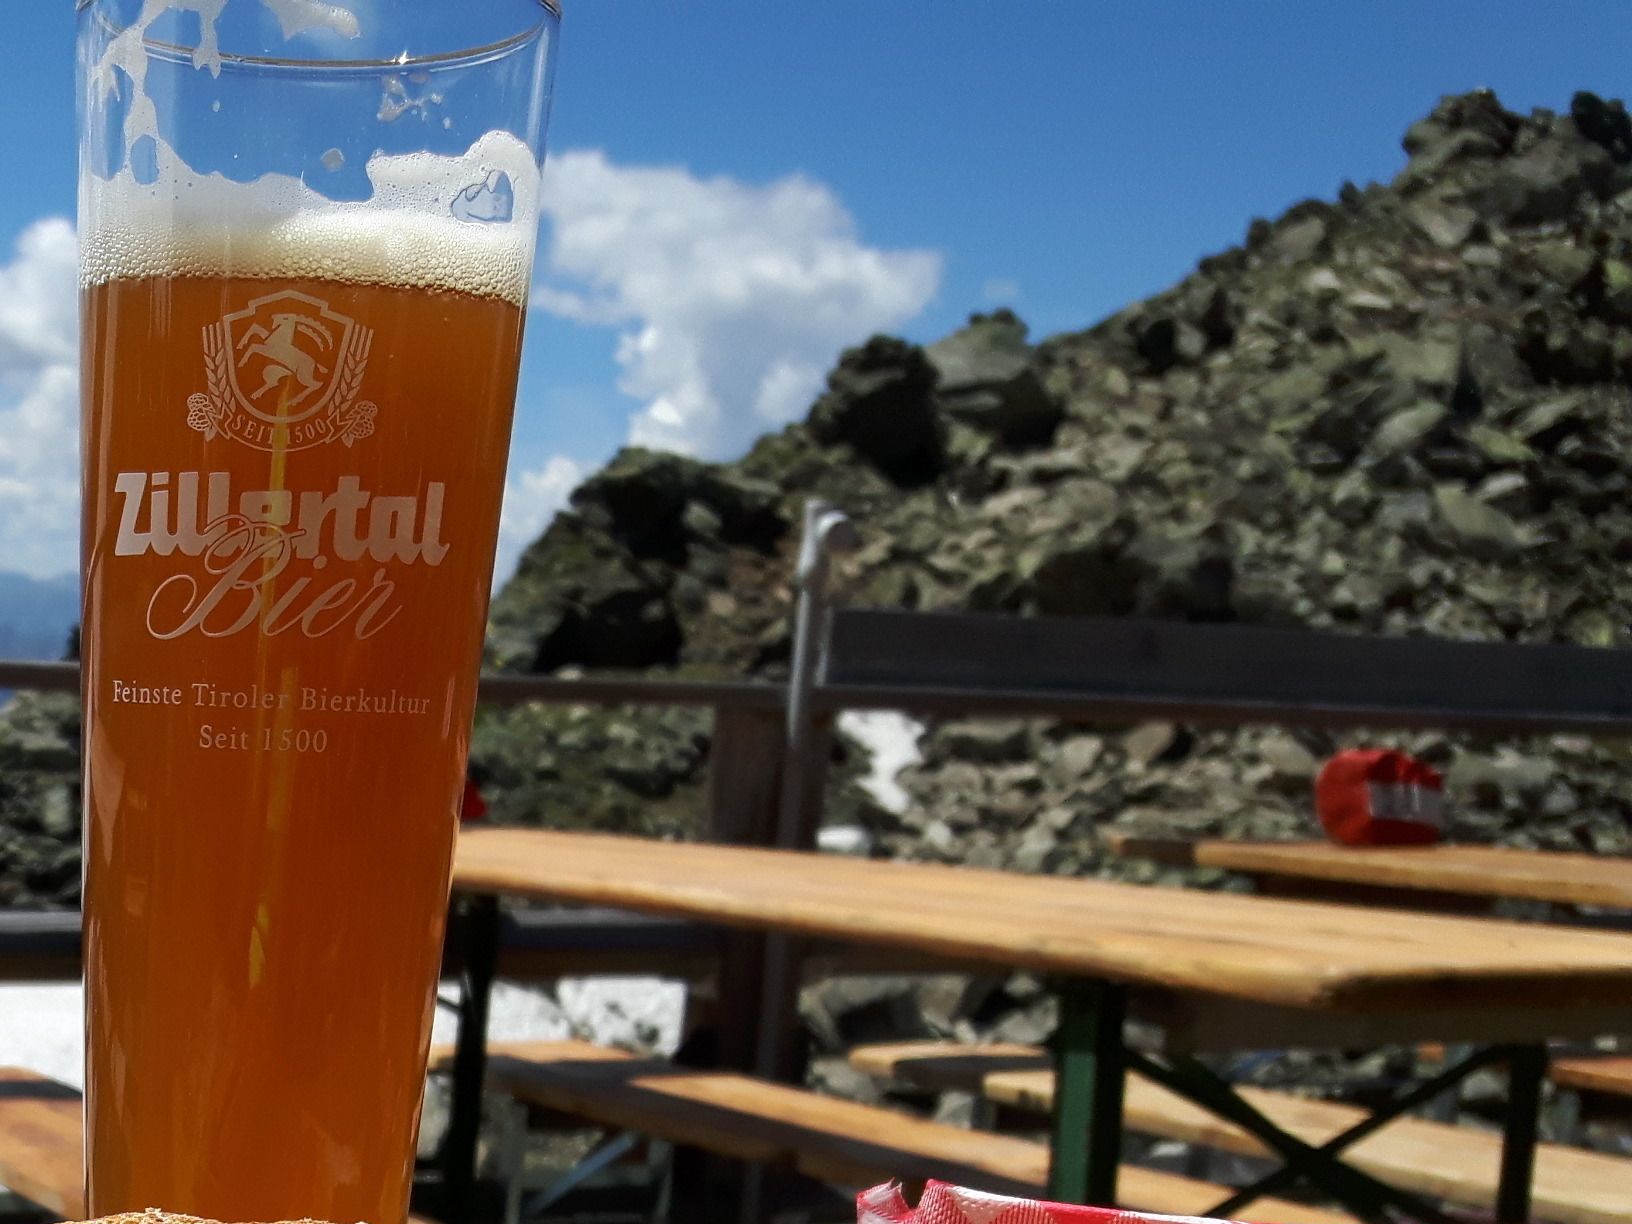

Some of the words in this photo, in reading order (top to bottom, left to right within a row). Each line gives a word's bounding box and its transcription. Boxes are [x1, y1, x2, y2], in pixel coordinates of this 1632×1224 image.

[231, 414, 274, 444] SEIT
[286, 418, 327, 445] 1500
[114, 471, 451, 567] Zillertal
[146, 514, 404, 641] Bier
[112, 680, 182, 705] Feinste
[191, 683, 289, 710] Tiroler
[301, 687, 431, 714] Bierkultur
[199, 725, 249, 751] Seit
[263, 728, 329, 753] 1500
